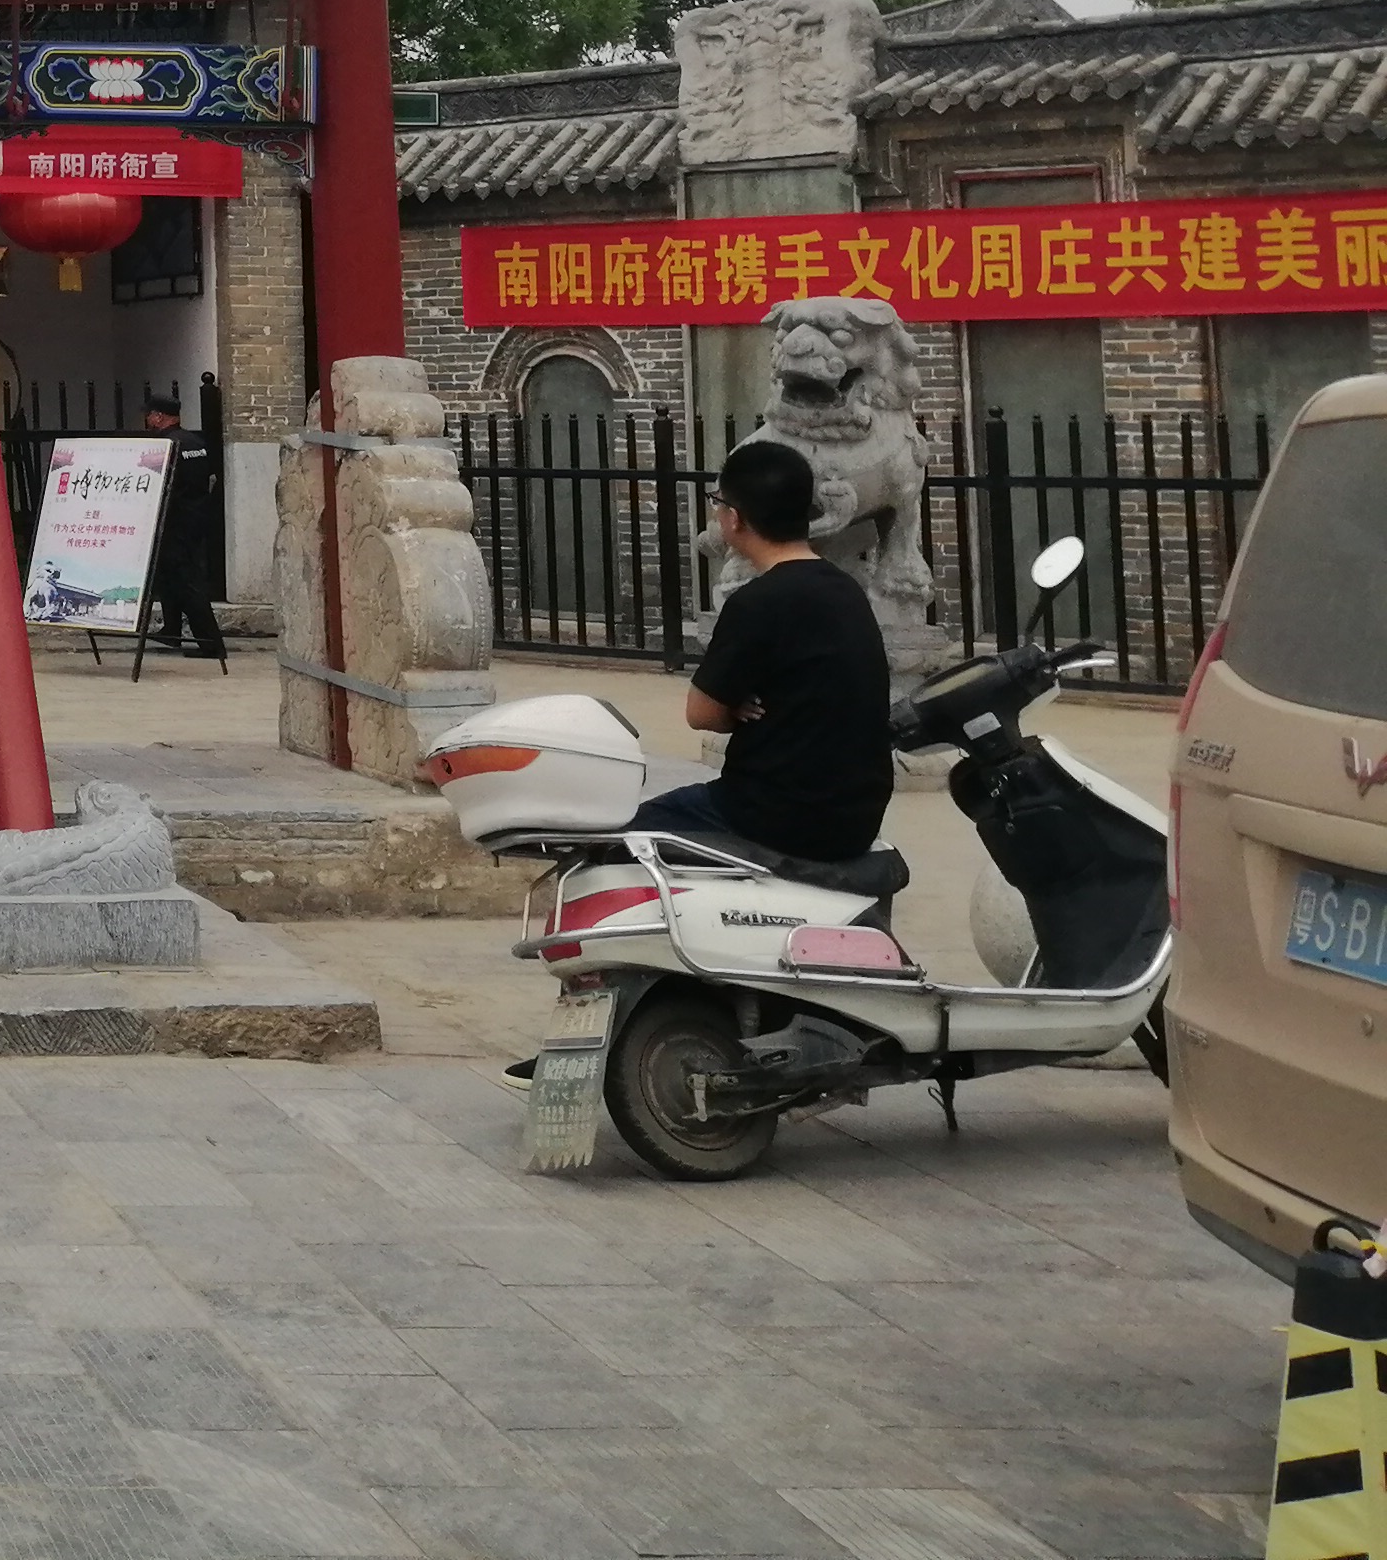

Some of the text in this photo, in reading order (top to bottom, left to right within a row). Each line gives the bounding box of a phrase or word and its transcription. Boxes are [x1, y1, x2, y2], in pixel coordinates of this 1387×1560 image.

[29, 152, 179, 180] 南阳府衙宣
[494, 207, 1387, 309] 南阳府衙携手文化周庄共建美丽
